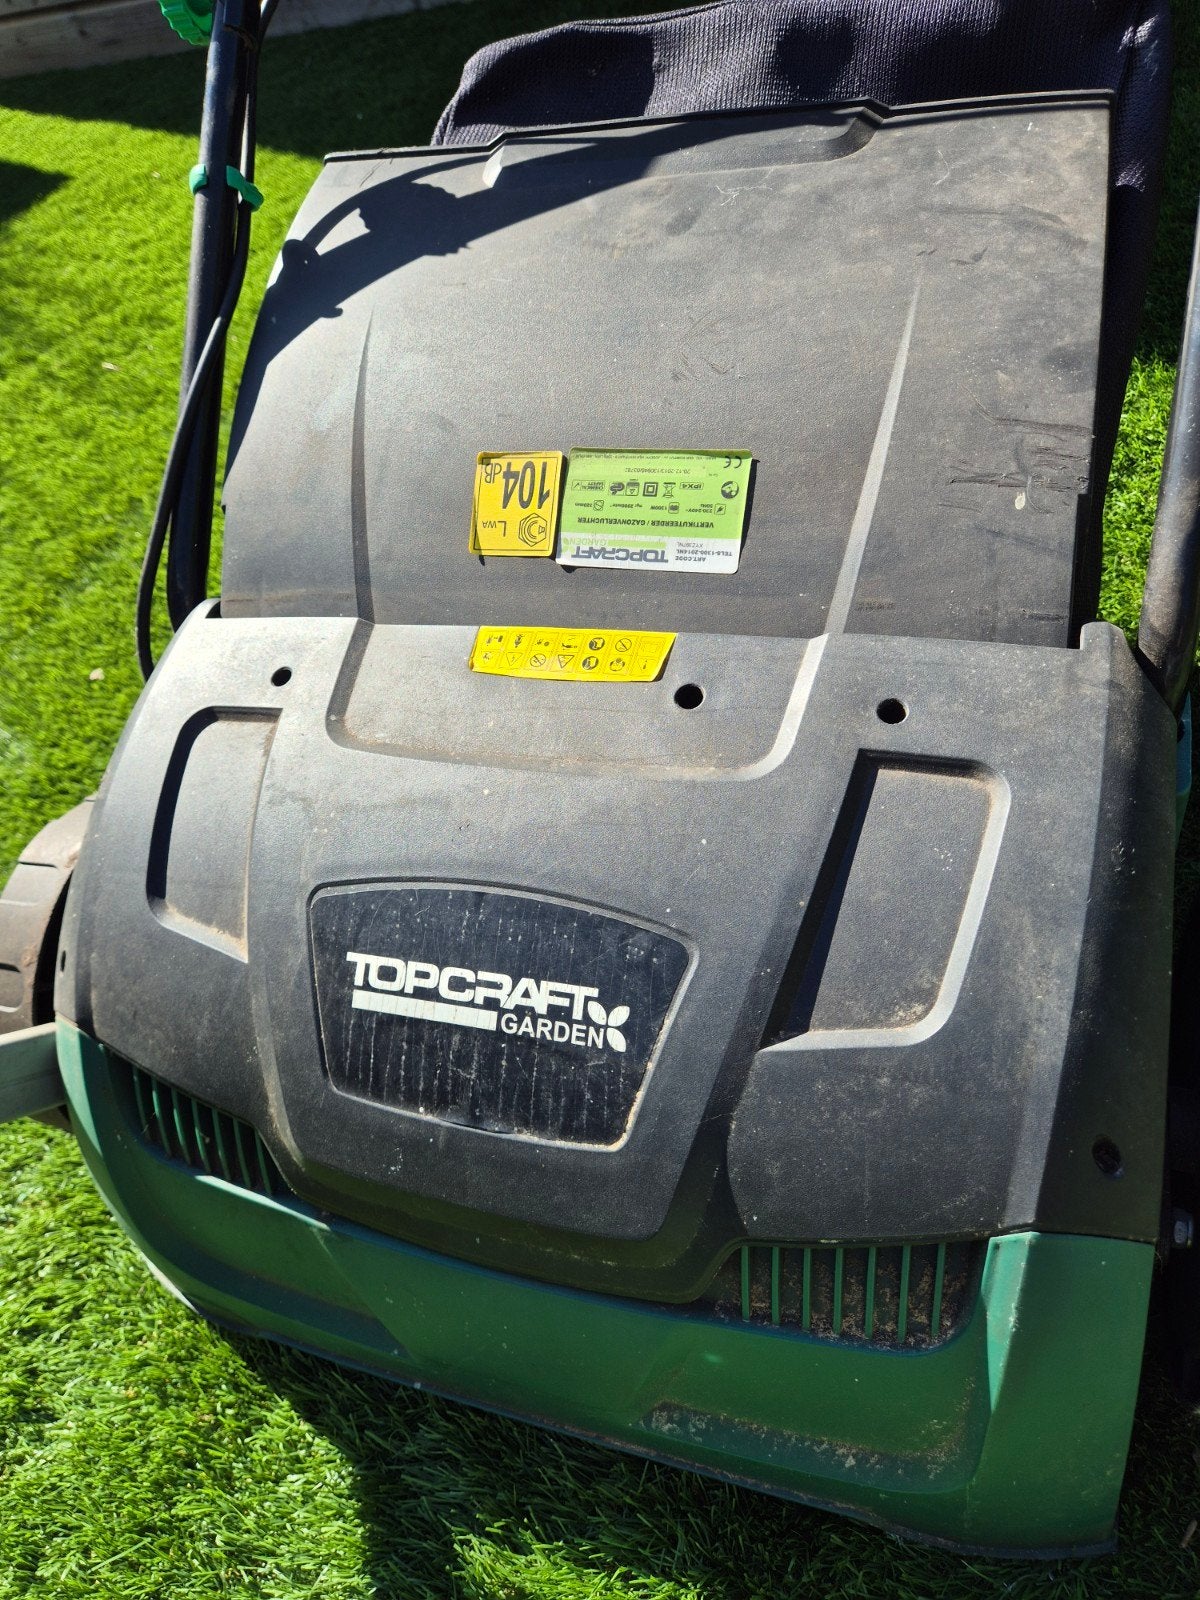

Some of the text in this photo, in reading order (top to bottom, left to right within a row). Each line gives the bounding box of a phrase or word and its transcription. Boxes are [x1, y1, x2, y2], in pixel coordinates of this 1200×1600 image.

[485, 461, 550, 510] 104 dB
[577, 517, 646, 526] GAZONVERLUCHTER
[568, 537, 607, 547] GARDEN
[571, 546, 669, 563] TOPCRAFT
[346, 951, 599, 1021] TOPCRAFT
[500, 1012, 604, 1049] GARDEN
